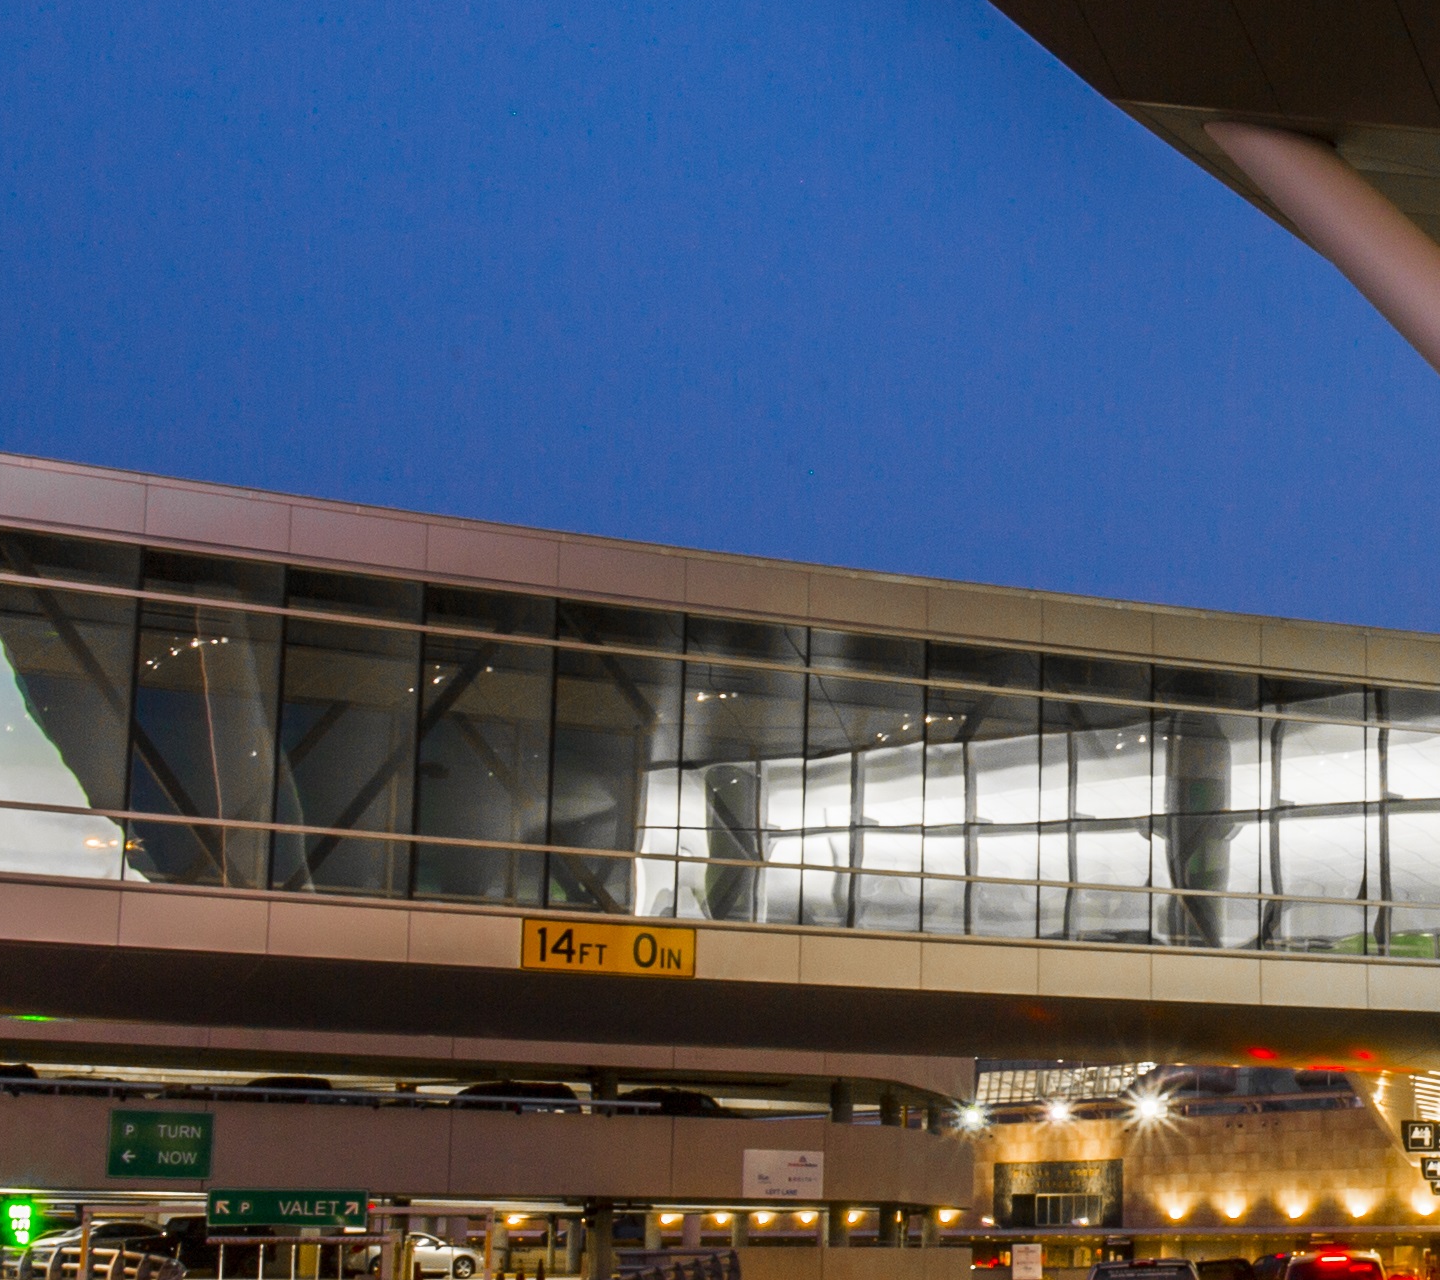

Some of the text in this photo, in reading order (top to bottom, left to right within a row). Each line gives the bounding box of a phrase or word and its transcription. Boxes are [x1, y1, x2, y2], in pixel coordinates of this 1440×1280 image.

[158, 1124, 202, 1139] TURN
[158, 1150, 198, 1165] NOW
[278, 1200, 340, 1216] VALET
